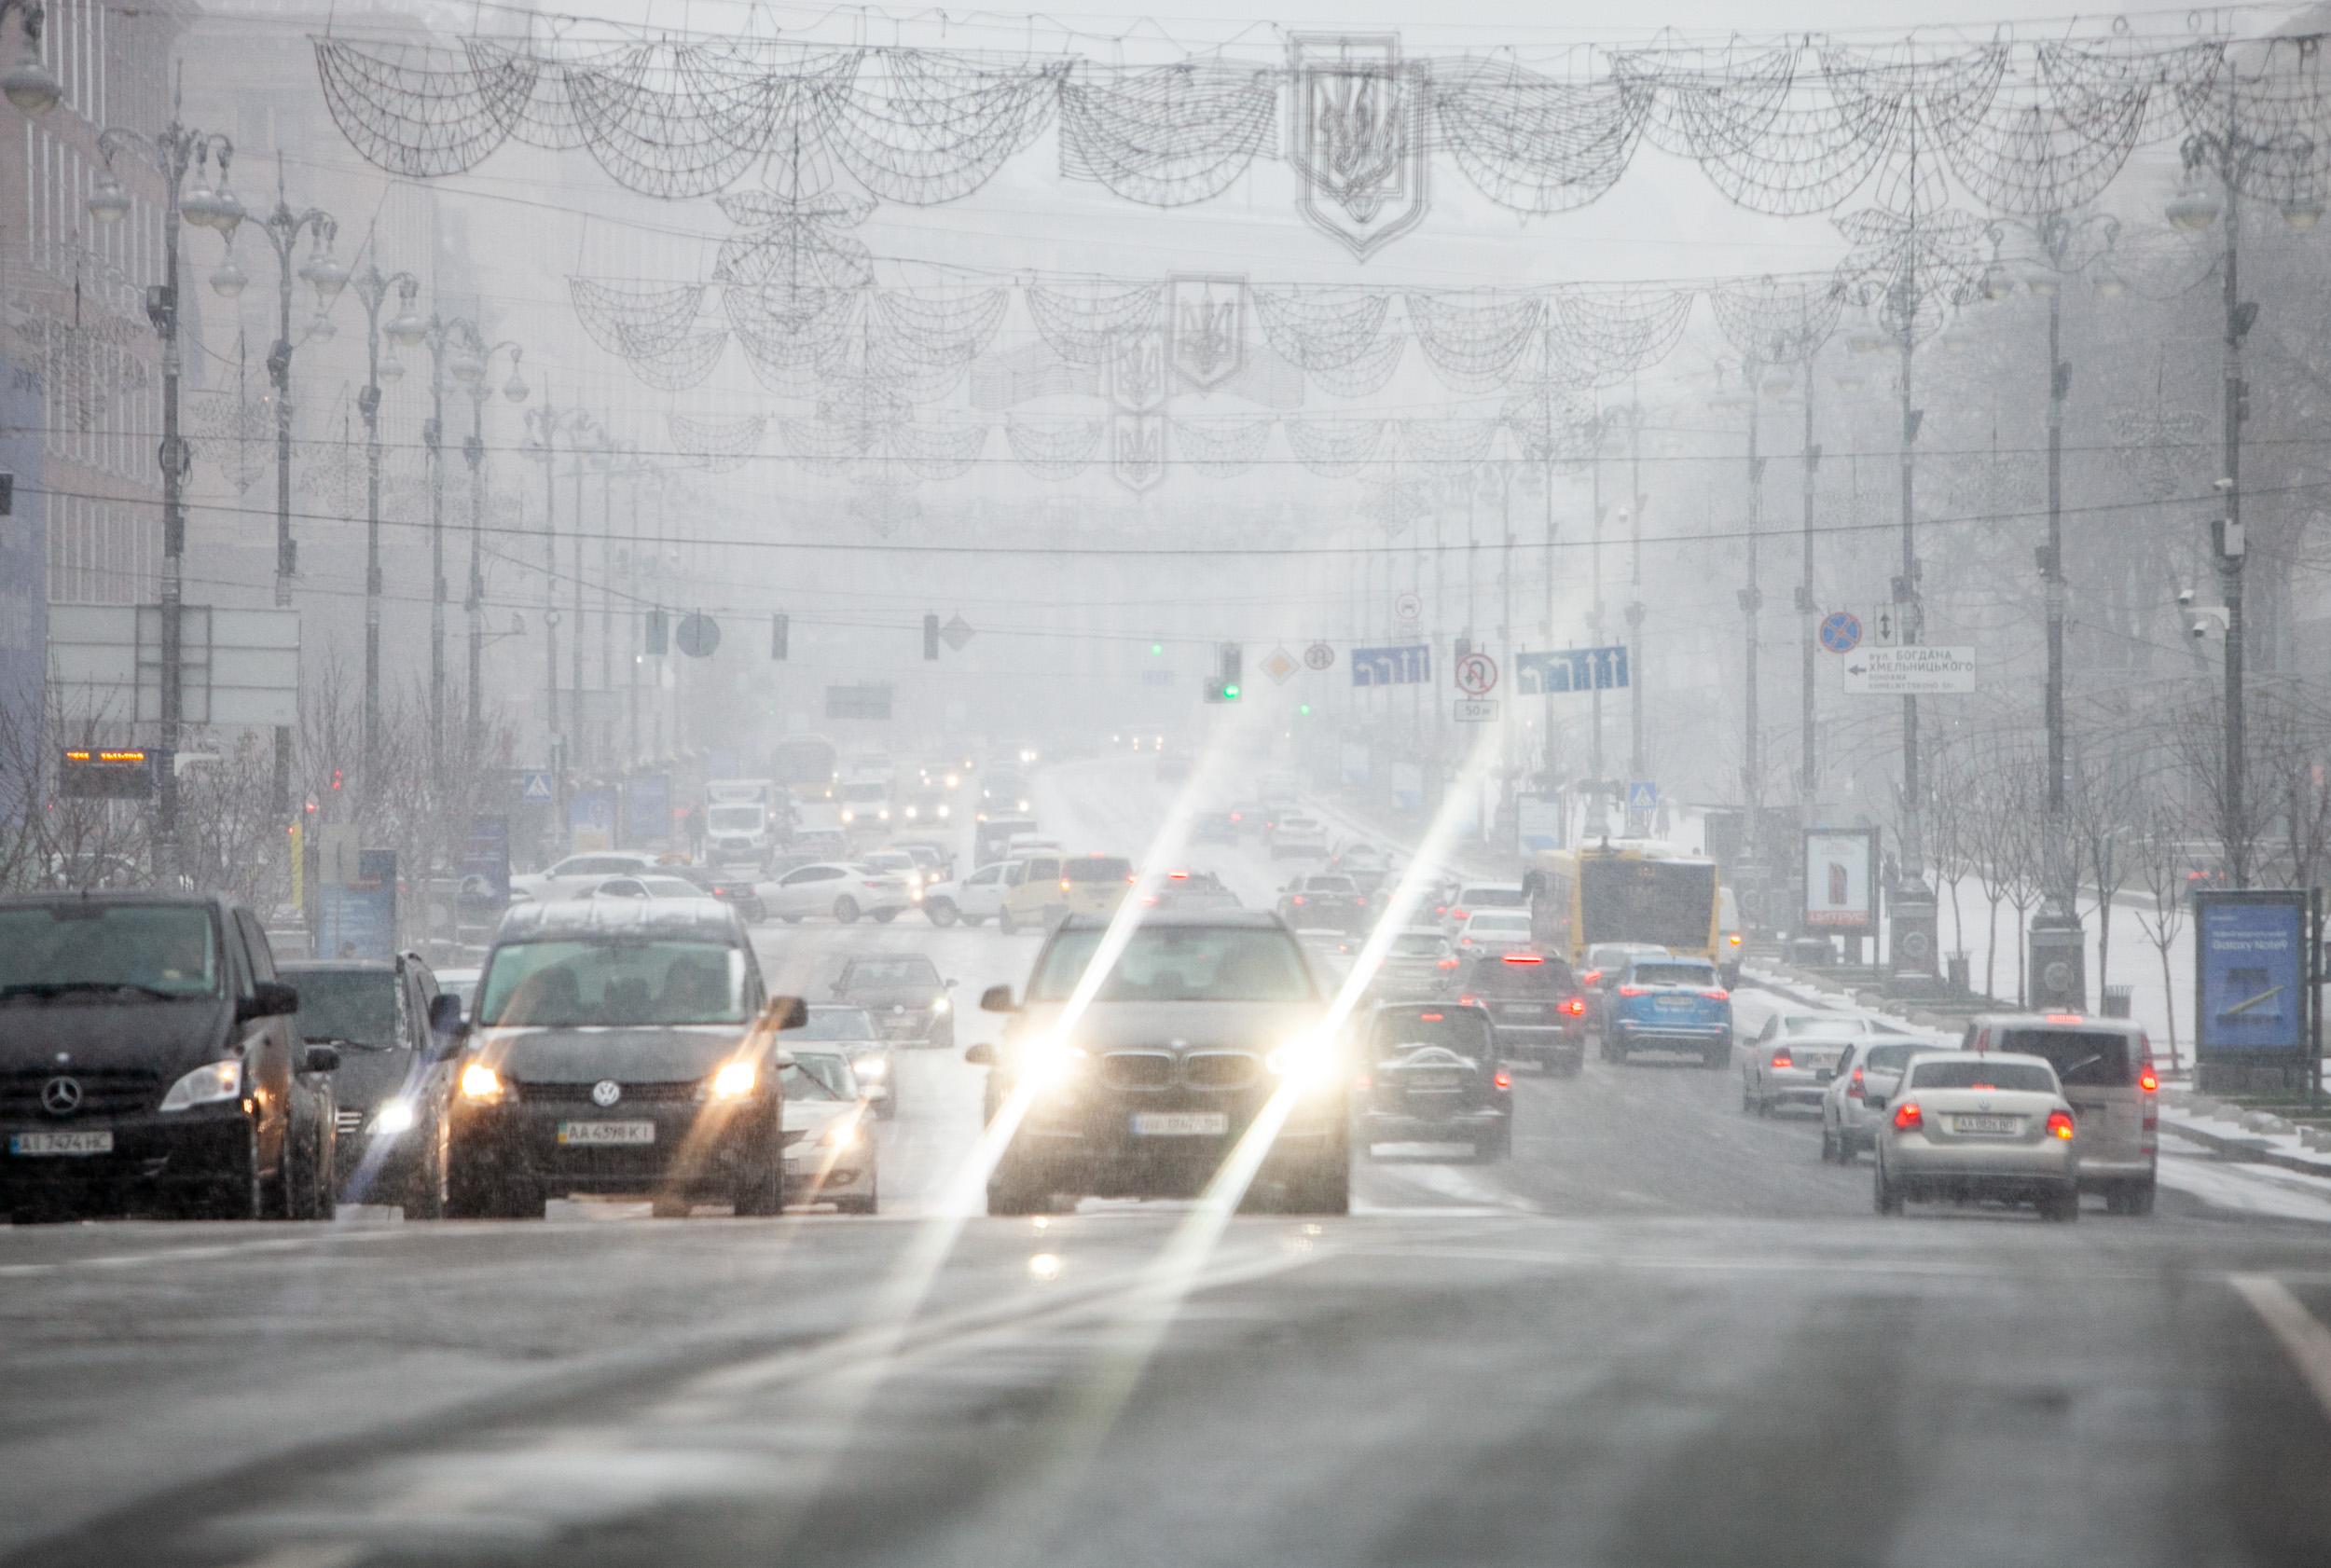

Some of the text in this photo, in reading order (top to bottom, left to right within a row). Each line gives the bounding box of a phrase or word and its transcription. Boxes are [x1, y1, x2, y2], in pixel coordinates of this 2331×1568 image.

[1896, 650, 1952, 661] БОГДАНА
[1869, 662, 1974, 673] ХМЕЛЬНИЦЬКОГО
[1465, 705, 1481, 717] 50
[569, 1124, 590, 1139] AA
